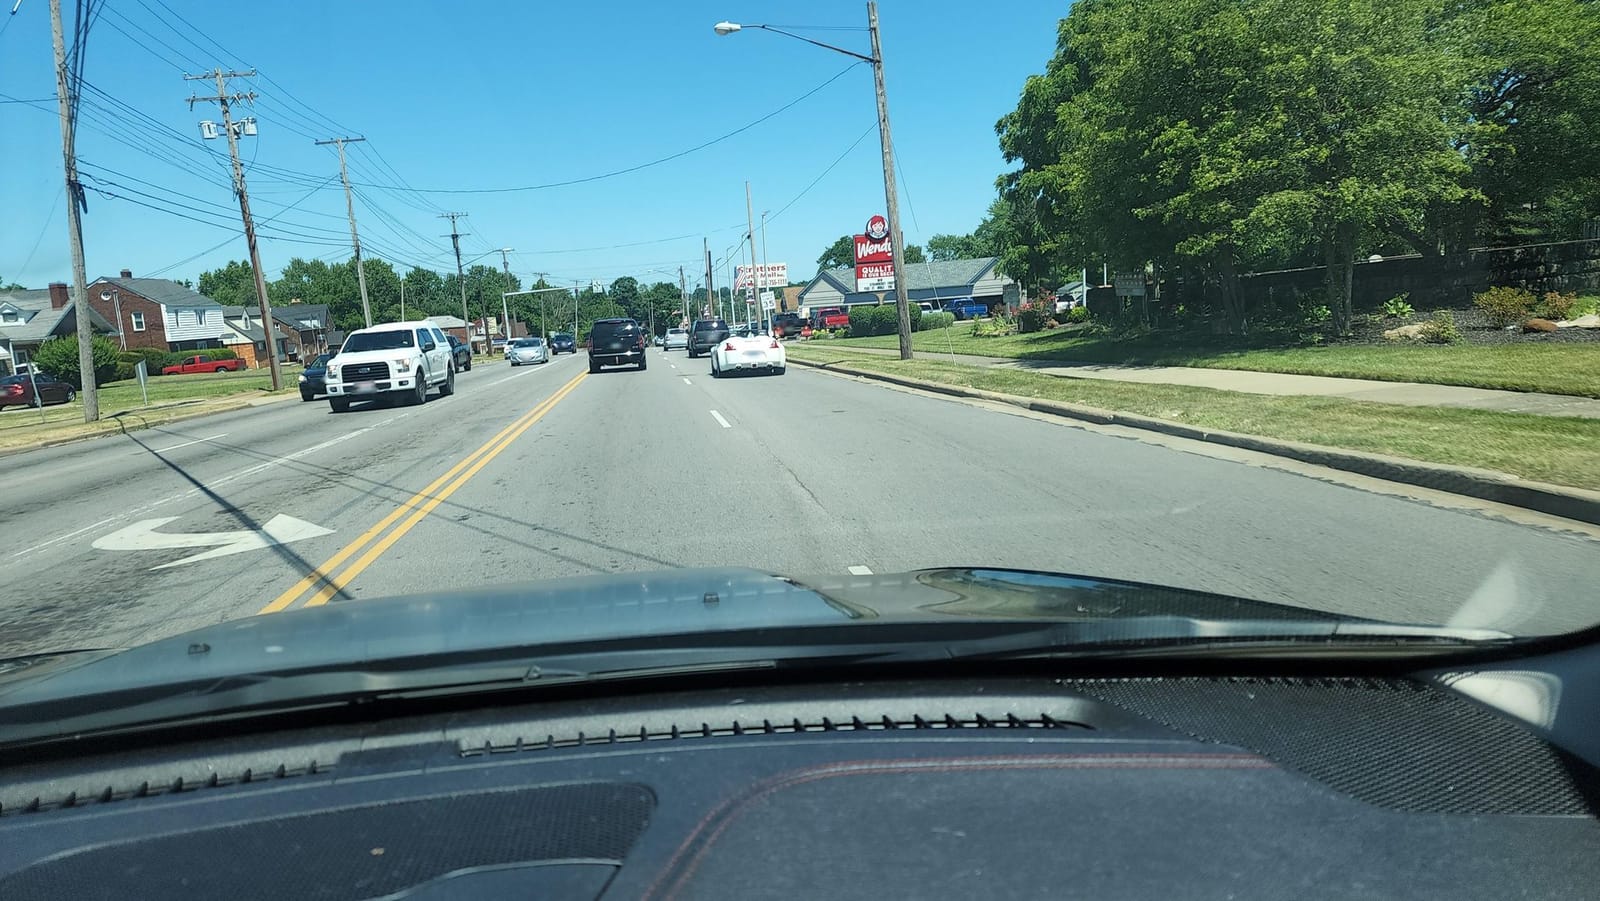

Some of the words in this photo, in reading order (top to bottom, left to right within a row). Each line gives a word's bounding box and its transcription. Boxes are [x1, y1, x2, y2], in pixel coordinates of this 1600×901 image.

[858, 237, 892, 258] Wendy
[862, 265, 892, 274] QUALIT
[764, 300, 774, 308] 35
